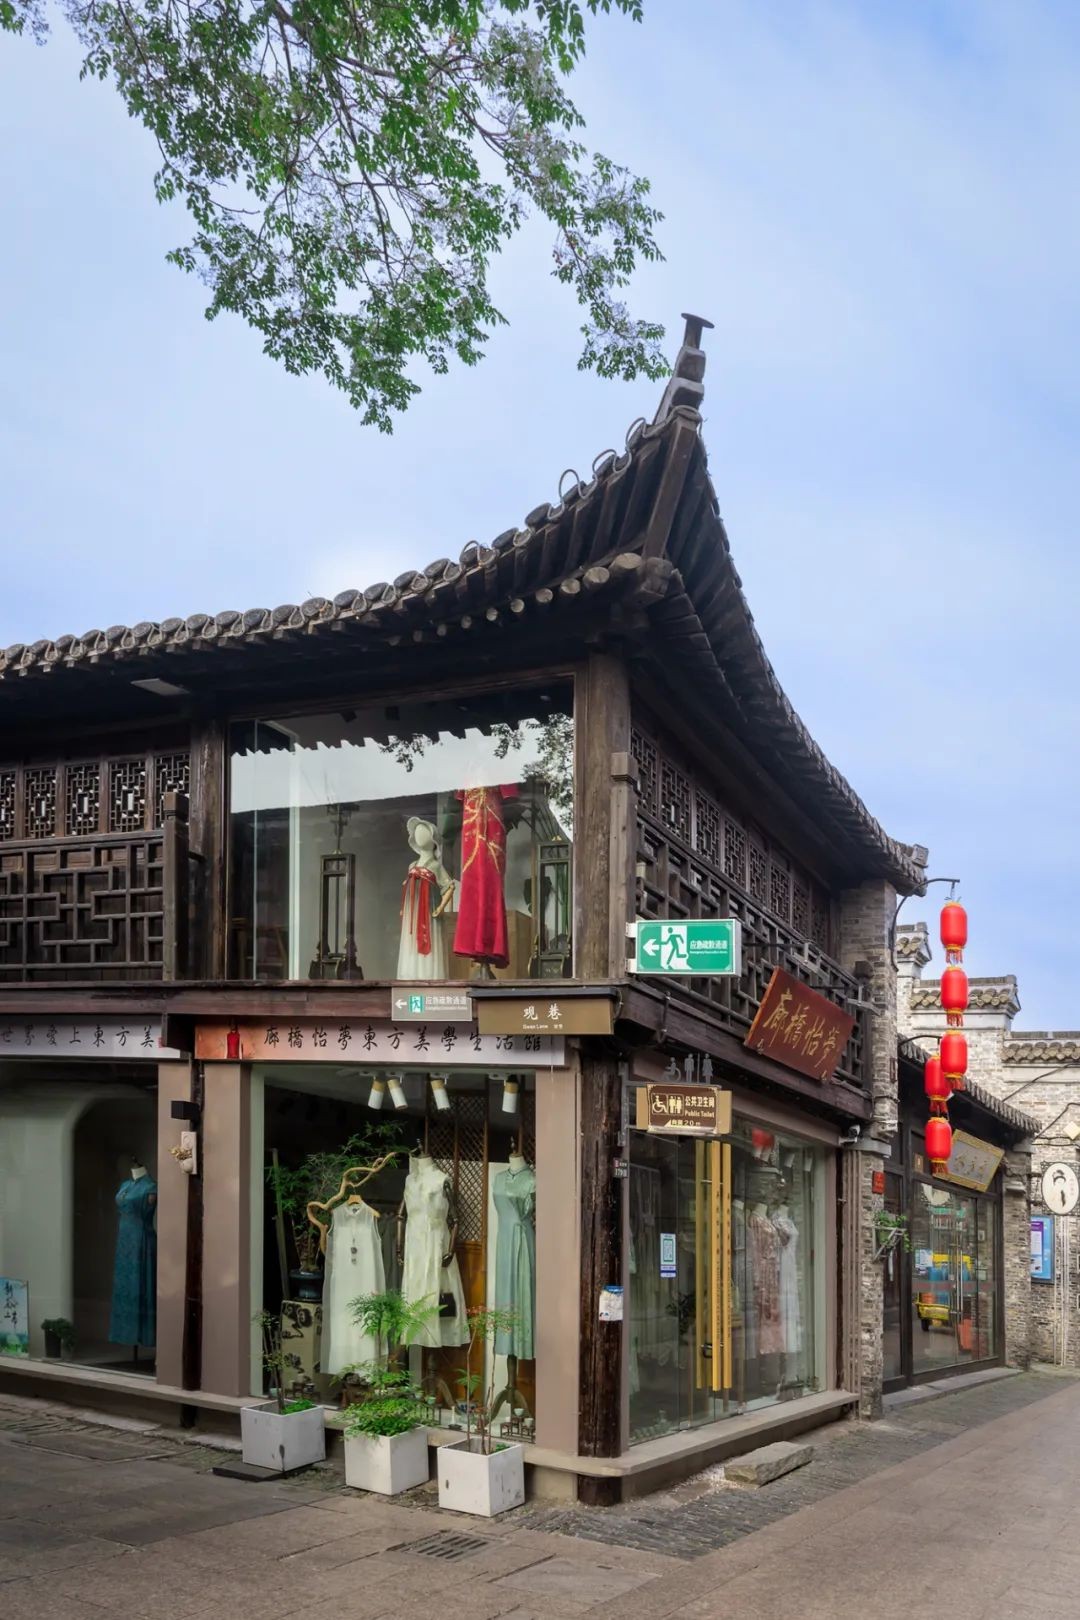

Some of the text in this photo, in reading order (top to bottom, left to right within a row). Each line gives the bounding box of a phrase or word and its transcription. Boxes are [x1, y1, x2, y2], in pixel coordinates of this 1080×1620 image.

[1, 1025, 155, 1047] 世界愛上東方美
[685, 1096, 715, 1108] 公共卫生间
[701, 1110, 715, 1118] Toilet
